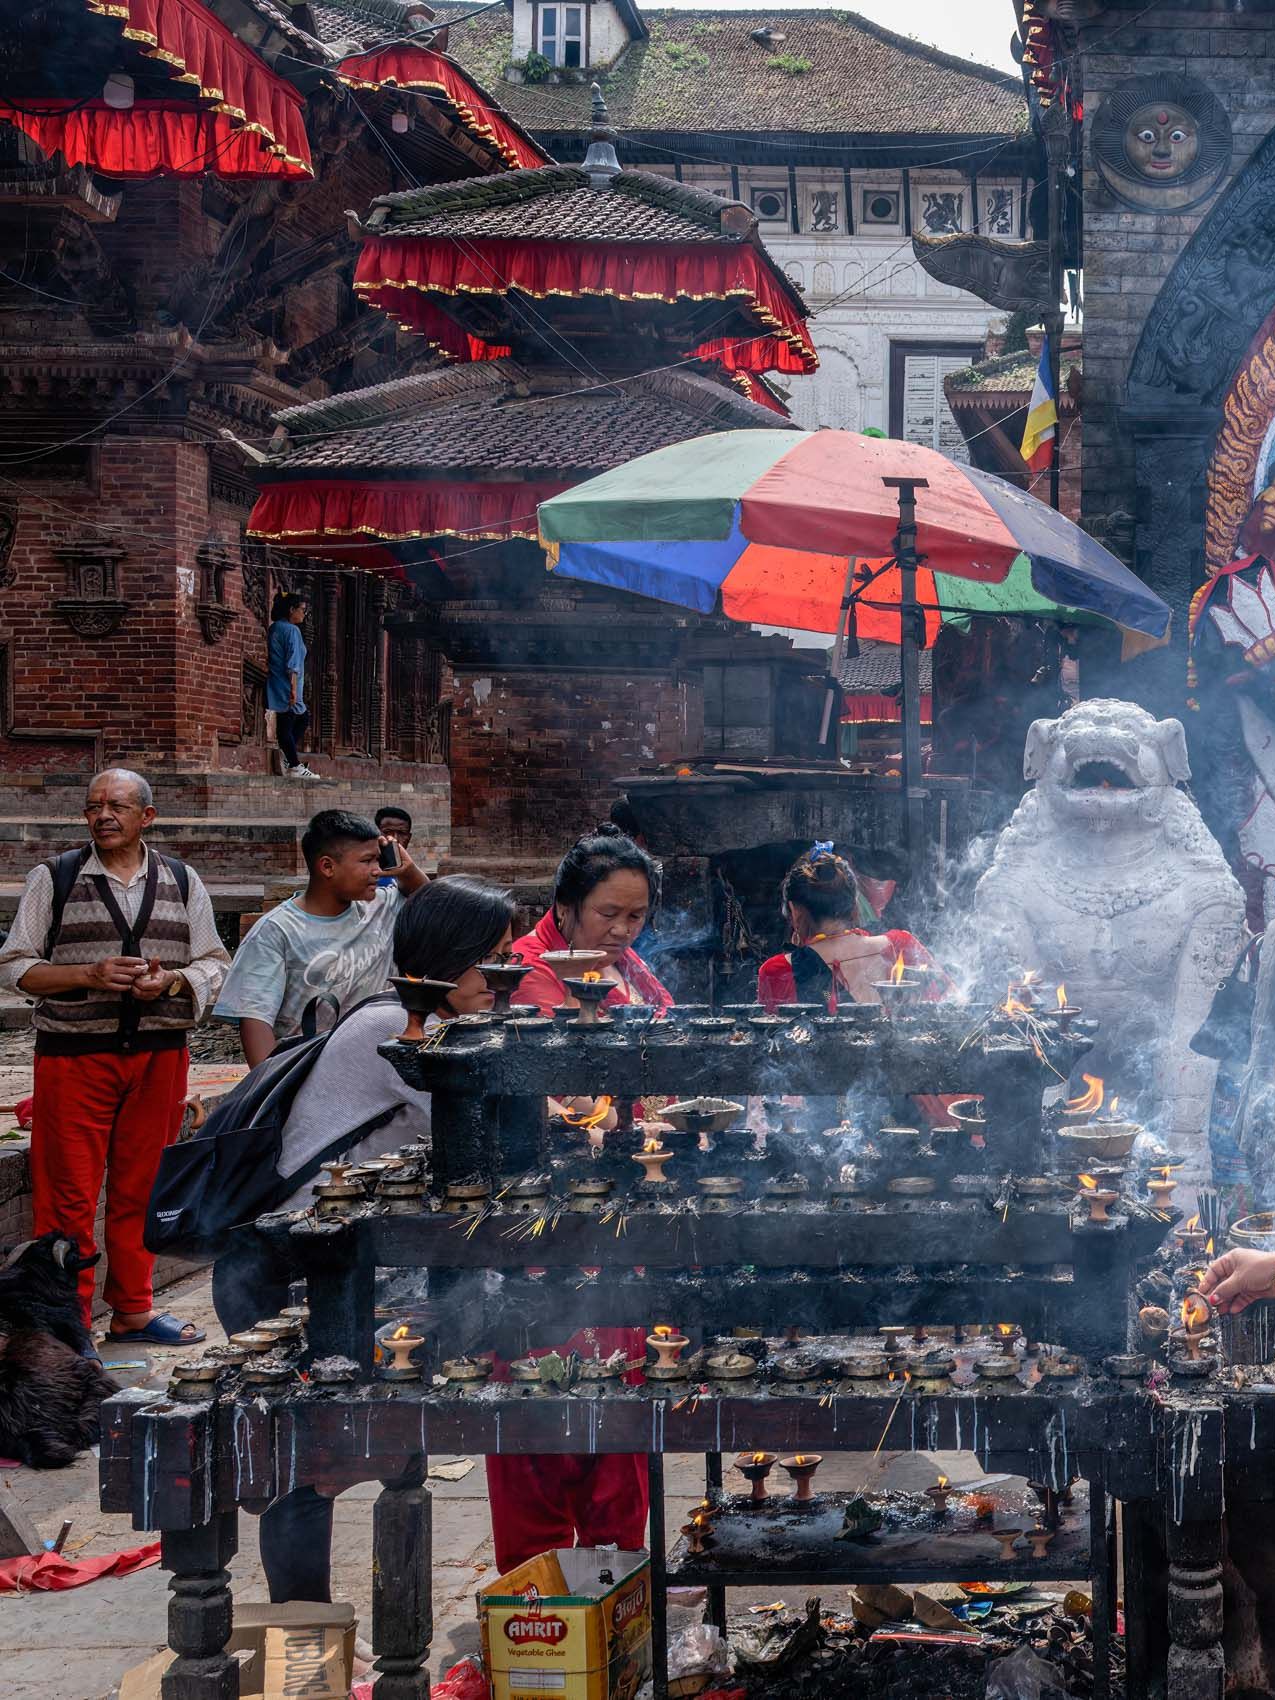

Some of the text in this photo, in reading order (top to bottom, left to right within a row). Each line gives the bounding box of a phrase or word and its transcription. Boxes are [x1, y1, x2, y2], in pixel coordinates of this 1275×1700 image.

[508, 1621, 563, 1637] AMRIT
[507, 1648, 566, 1657] Vegetable Ghee
